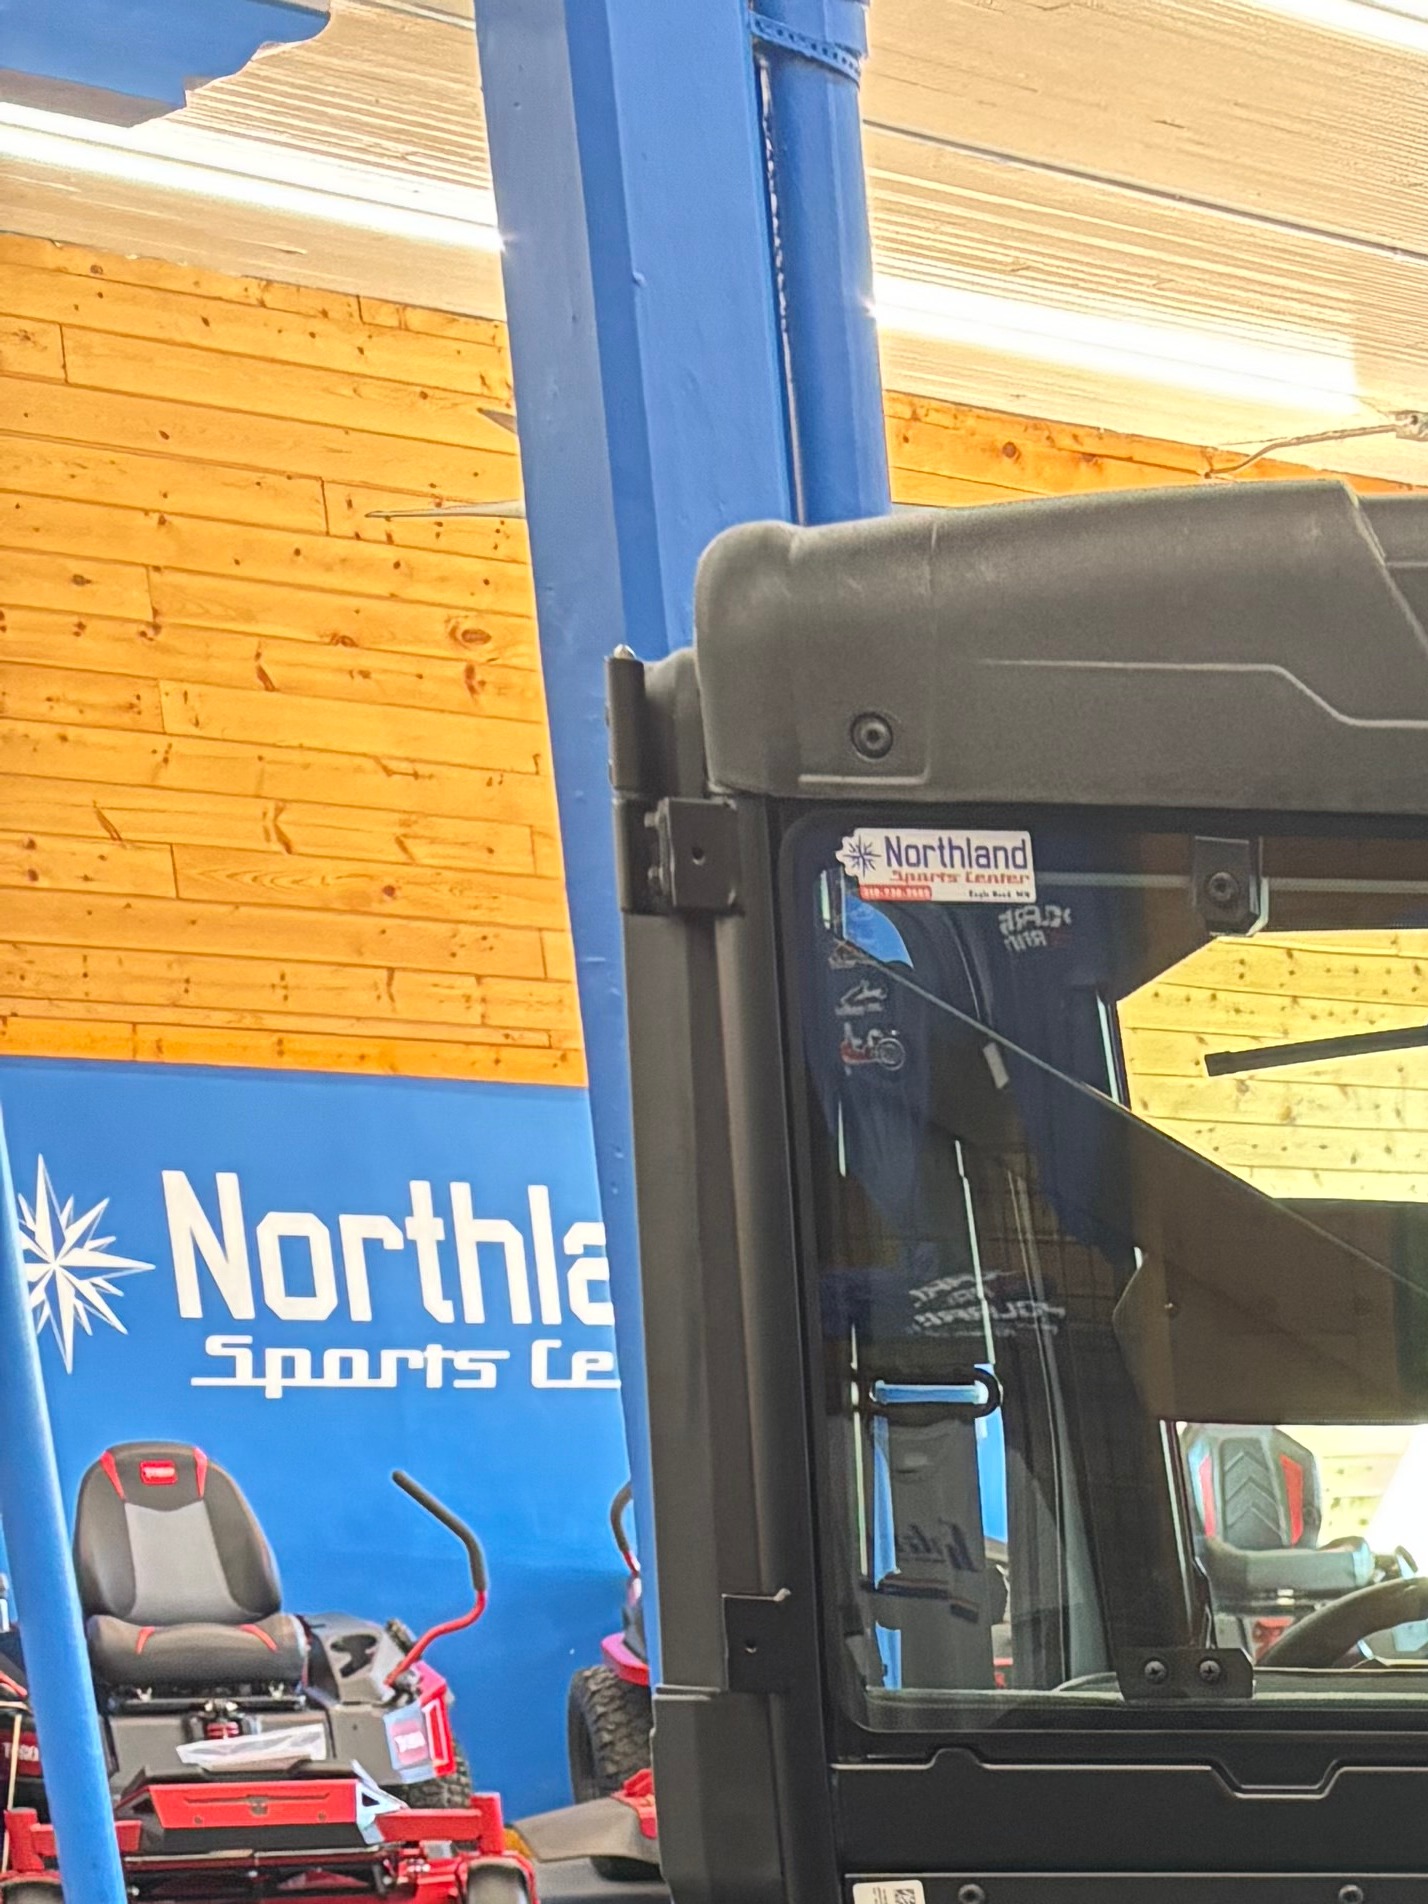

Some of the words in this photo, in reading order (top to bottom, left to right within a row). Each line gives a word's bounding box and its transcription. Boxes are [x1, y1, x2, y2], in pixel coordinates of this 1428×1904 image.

[884, 835, 1028, 870] Northland
[889, 870, 961, 885] Sports
[964, 870, 1031, 884] Center
[191, 1335, 511, 1399] Sports
